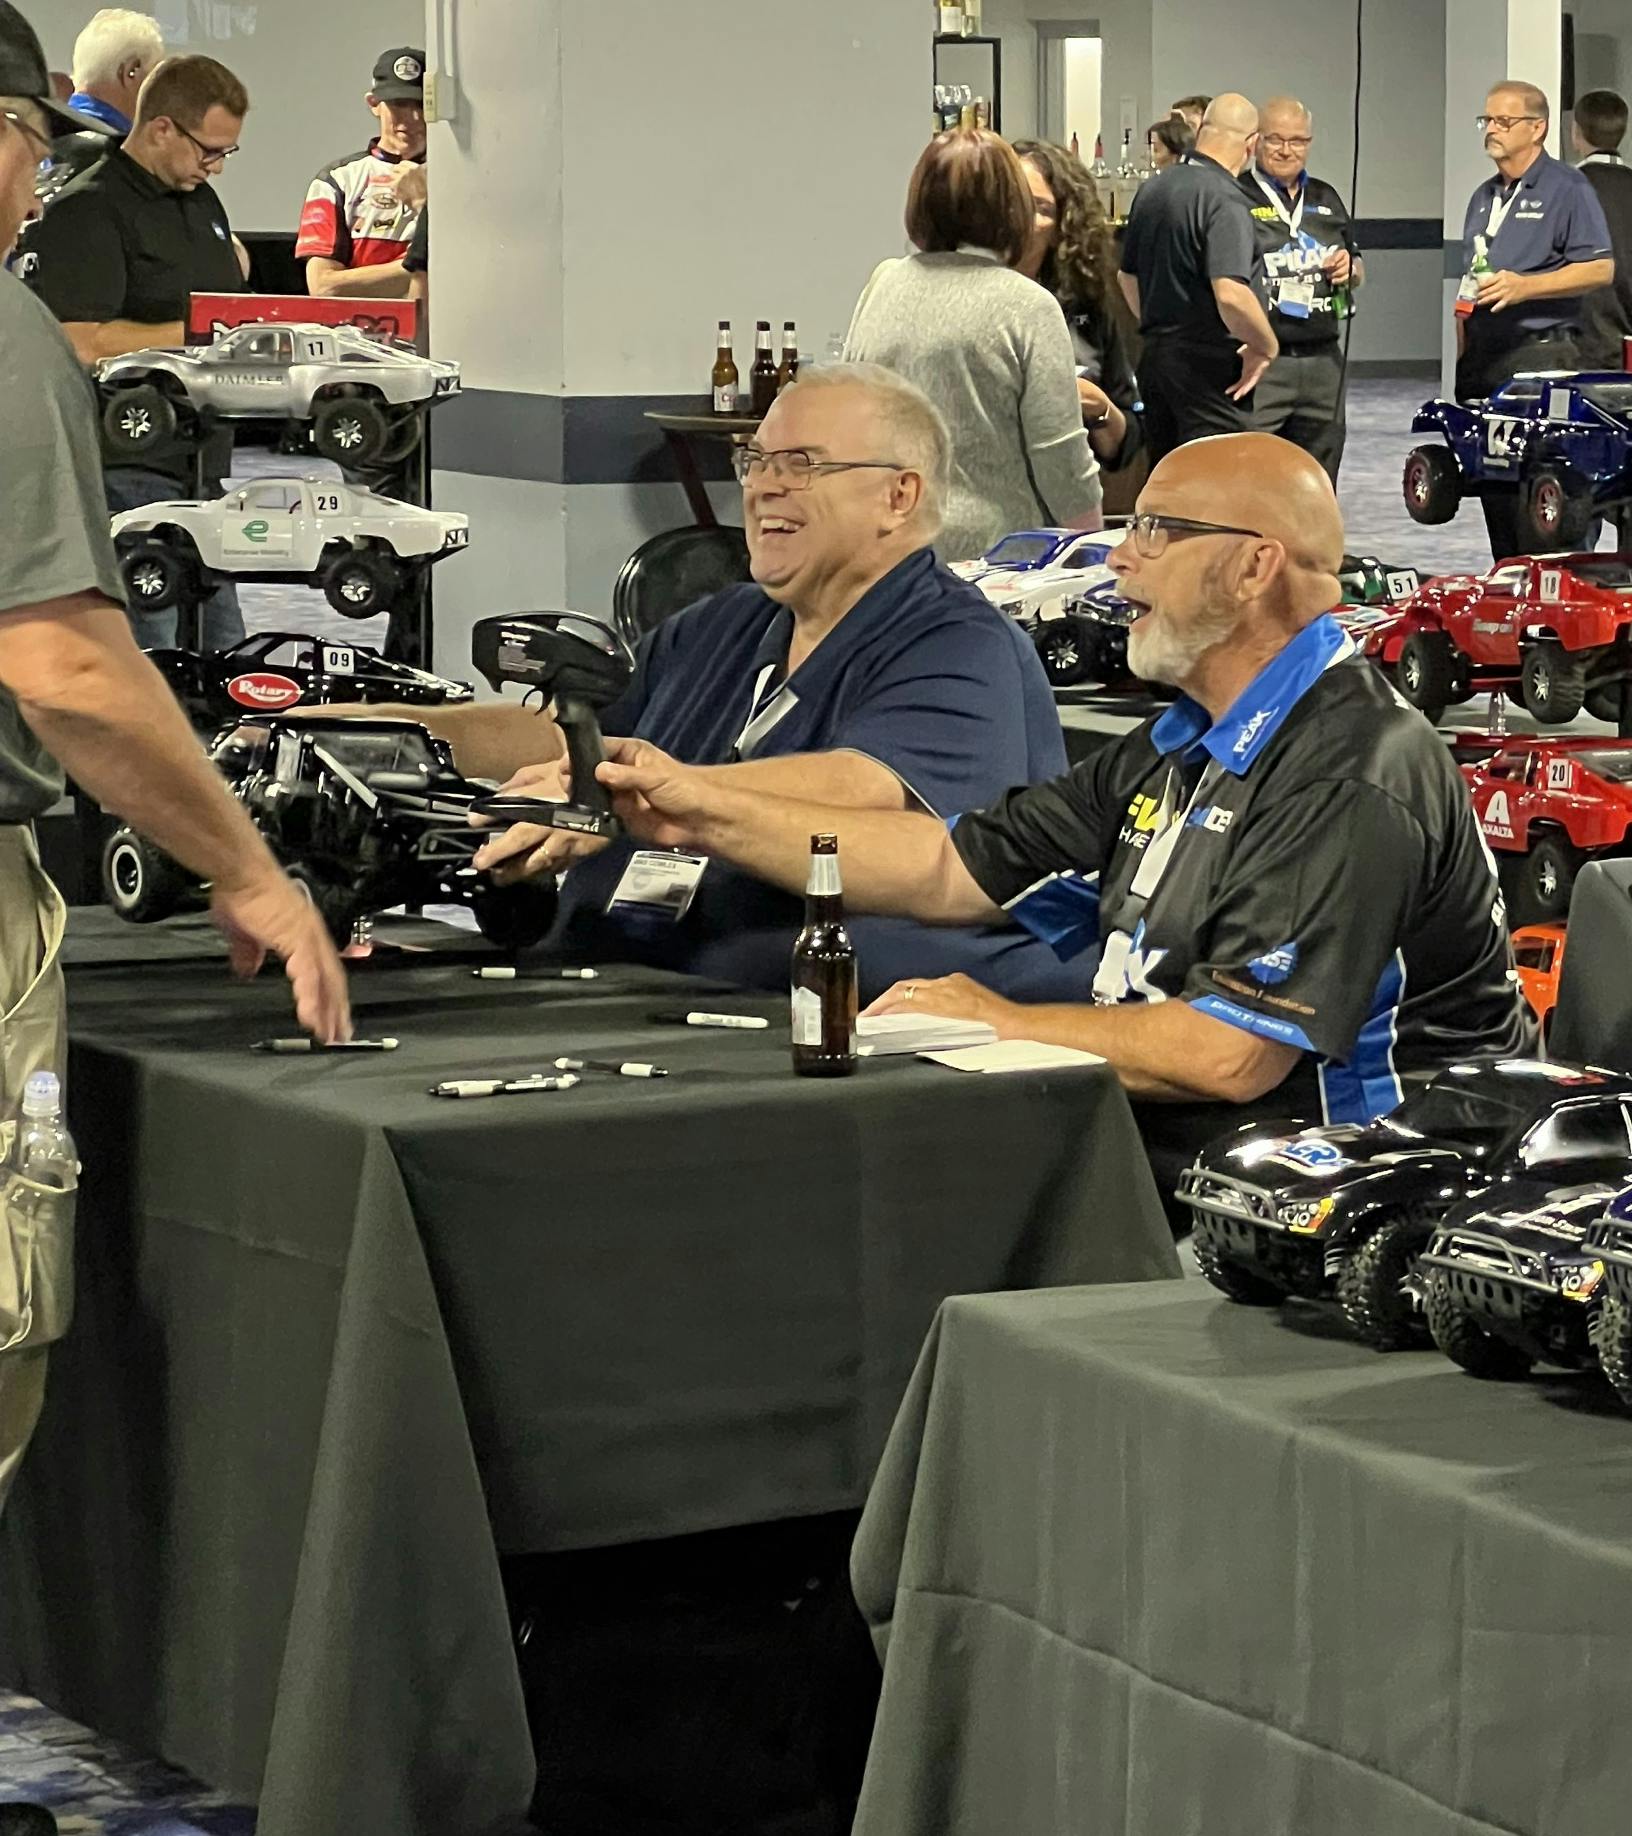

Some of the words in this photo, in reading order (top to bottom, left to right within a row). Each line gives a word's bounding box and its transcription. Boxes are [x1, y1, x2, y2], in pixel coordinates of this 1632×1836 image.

[307, 341, 324, 357] 17
[317, 495, 338, 511] 29
[1394, 576, 1415, 594] 51
[328, 651, 350, 668] 09
[238, 679, 294, 698] Rotary
[1232, 709, 1272, 753] PEAK
[1551, 764, 1565, 782] 20
[1482, 823, 1515, 839] AXALTA
